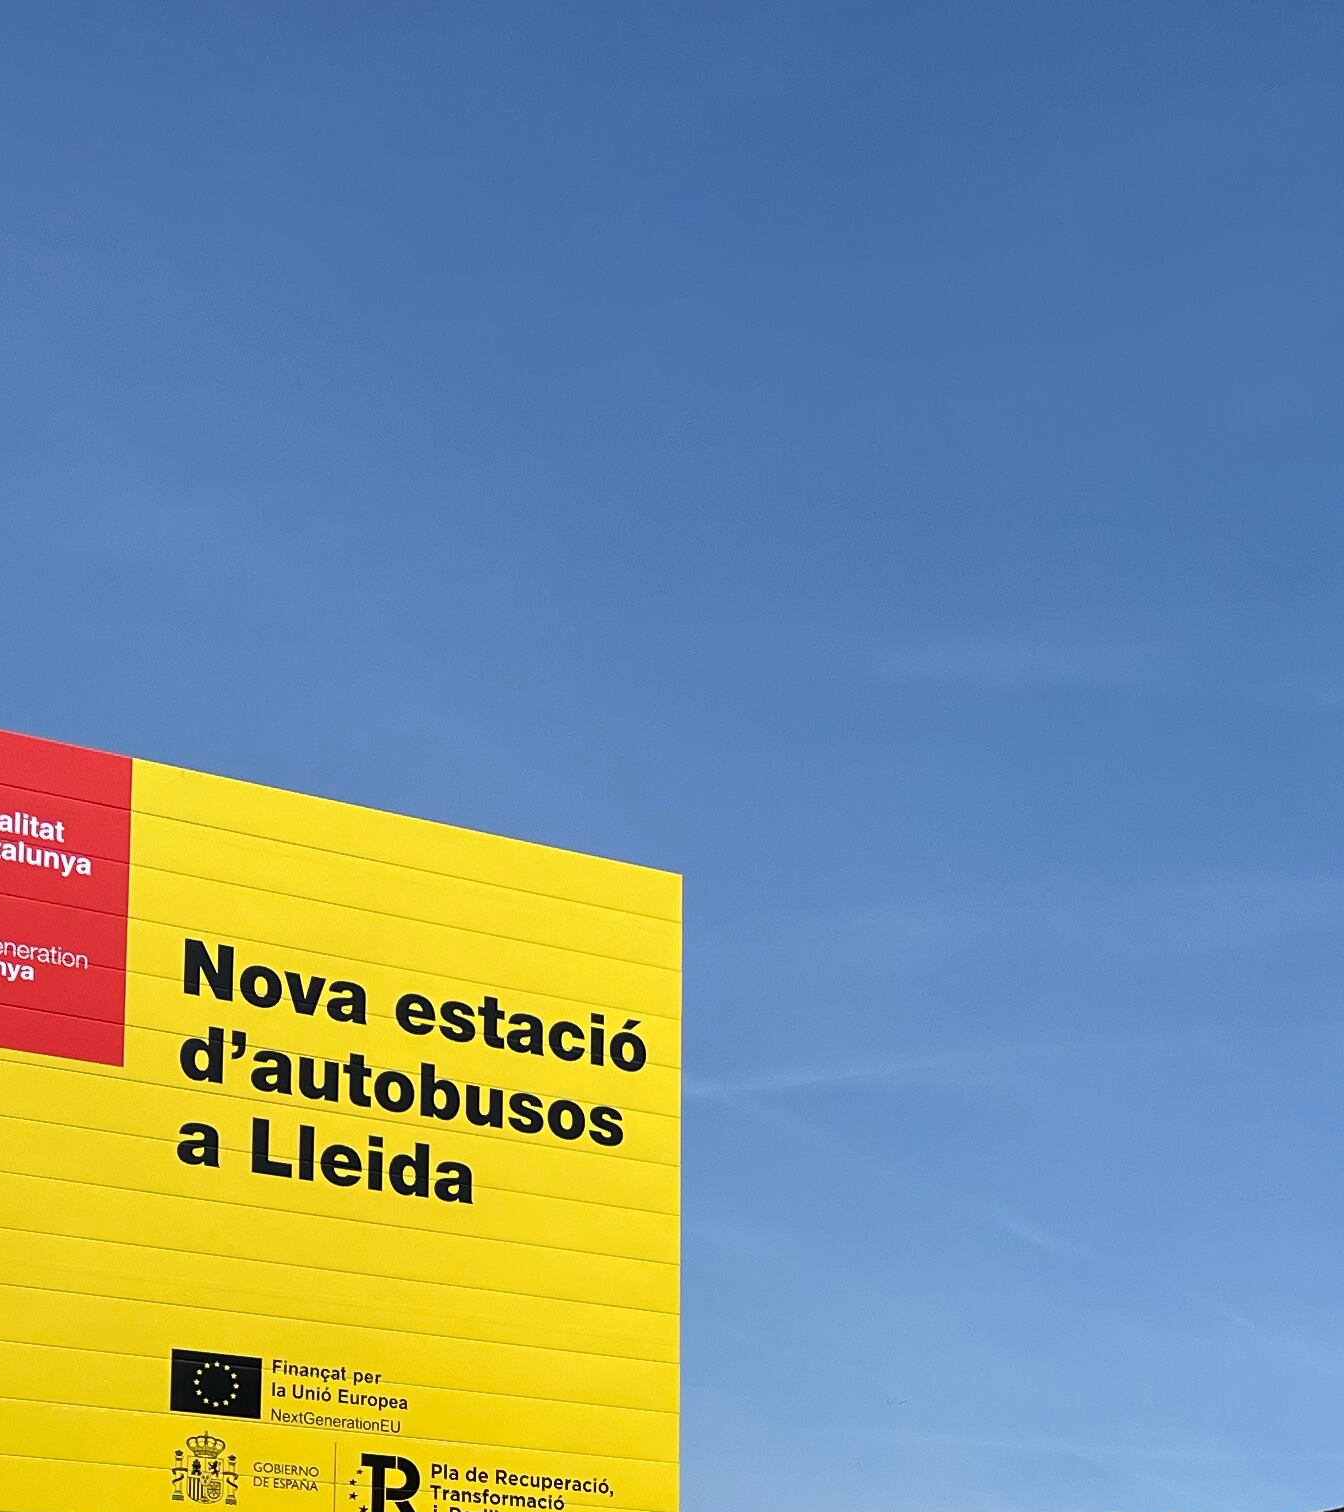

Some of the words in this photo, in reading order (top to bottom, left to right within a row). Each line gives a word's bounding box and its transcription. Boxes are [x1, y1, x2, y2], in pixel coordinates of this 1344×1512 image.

[183, 938, 367, 1025] Nova
[395, 991, 647, 1073] estació
[179, 1027, 624, 1147] d’autobusos
[176, 1121, 220, 1168] a
[251, 1117, 474, 1205] Lleida
[272, 1360, 347, 1384] Finançat
[353, 1368, 382, 1387] per
[272, 1382, 287, 1399] la
[292, 1383, 332, 1404] Unió
[338, 1387, 408, 1413] Europea
[271, 1408, 402, 1434] NextGenerationEU
[253, 1461, 320, 1479] GOBIERNO
[253, 1476, 270, 1489] DE
[273, 1475, 319, 1492] ESPAÑA
[431, 1463, 461, 1482] Pla
[465, 1466, 490, 1484] de
[494, 1468, 615, 1498] Recuperació,
[430, 1484, 565, 1512] Transformació
